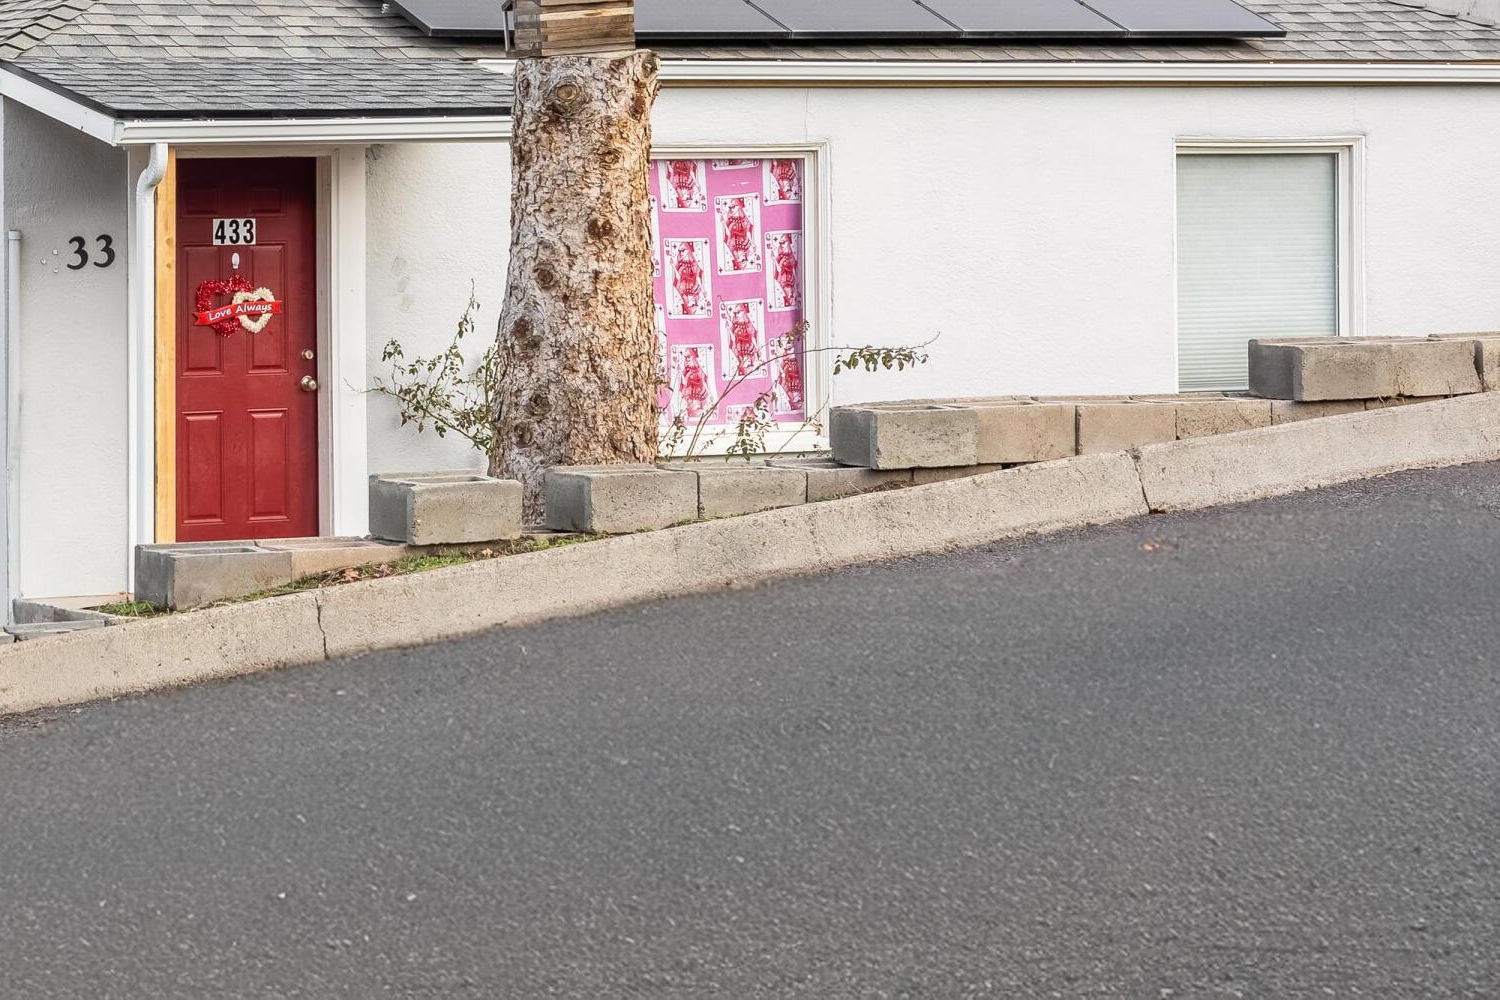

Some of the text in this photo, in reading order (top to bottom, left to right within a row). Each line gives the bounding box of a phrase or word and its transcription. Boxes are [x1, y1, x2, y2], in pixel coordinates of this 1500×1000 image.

[214, 219, 255, 245] 433
[66, 234, 116, 270] 33
[208, 303, 273, 321] Love Always
